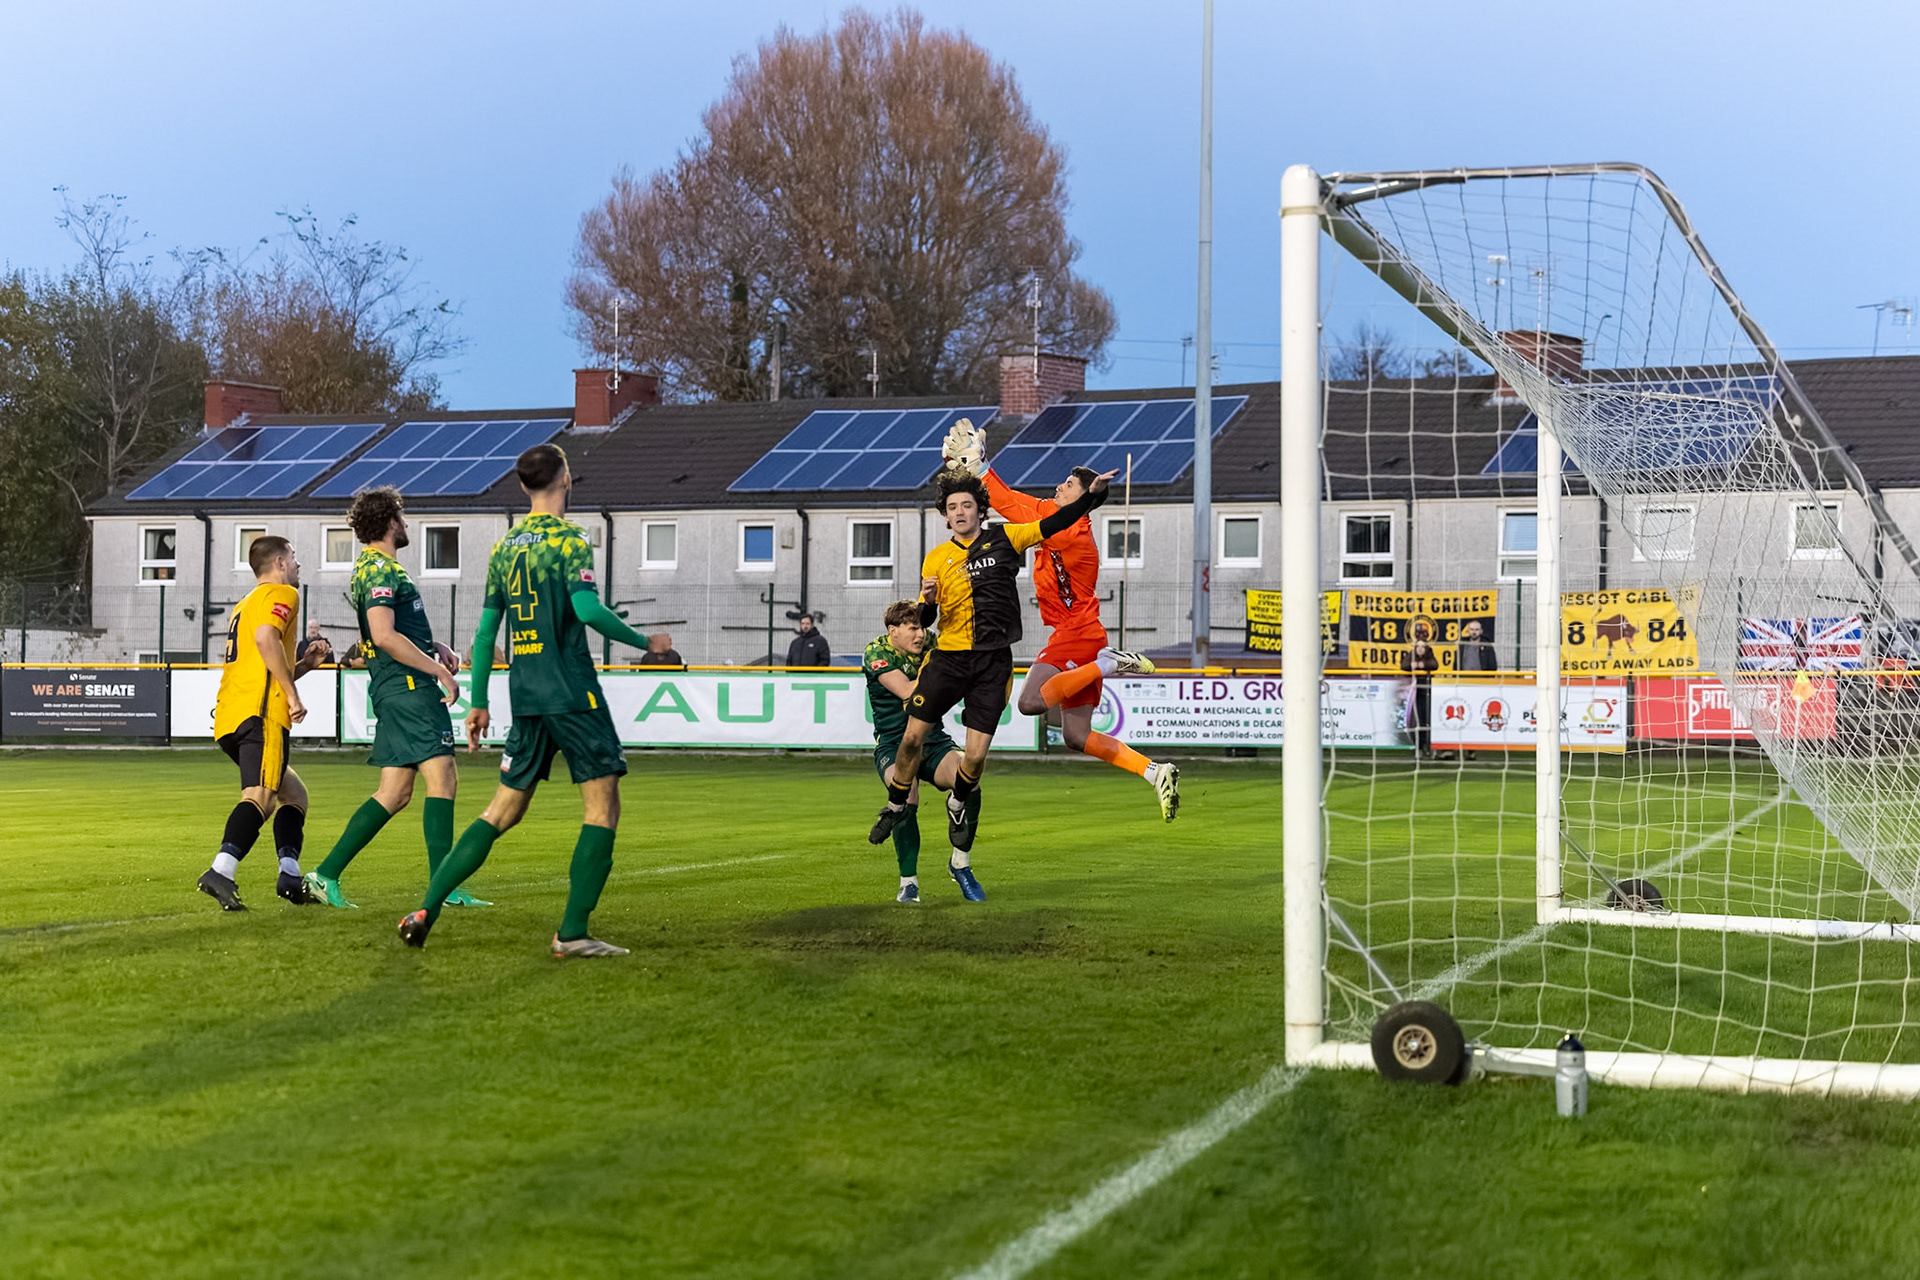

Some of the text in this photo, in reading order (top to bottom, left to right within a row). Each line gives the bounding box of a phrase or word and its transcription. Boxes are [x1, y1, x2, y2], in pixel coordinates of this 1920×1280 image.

[508, 549, 538, 621] 4
[1355, 595, 1490, 613] PRESCOT CABLES
[1560, 592, 1620, 606] ESCOT
[1370, 620, 1397, 640] 18
[1648, 617, 1687, 642] 84
[1249, 636, 1282, 651] PRESCO
[1560, 657, 1694, 670] ESCOT AWAY LADS
[32, 685, 135, 696] WE ARE SENATE
[1179, 681, 1234, 700] I.E.D.
[1141, 706, 1191, 714] ELECTRICAL
[1203, 707, 1262, 715] MECHANICAL
[1156, 720, 1240, 728] COMMUNICATIONS
[1136, 730, 1153, 738] 0151
[1156, 730, 1172, 738] 427
[1175, 730, 1197, 738] 8500
